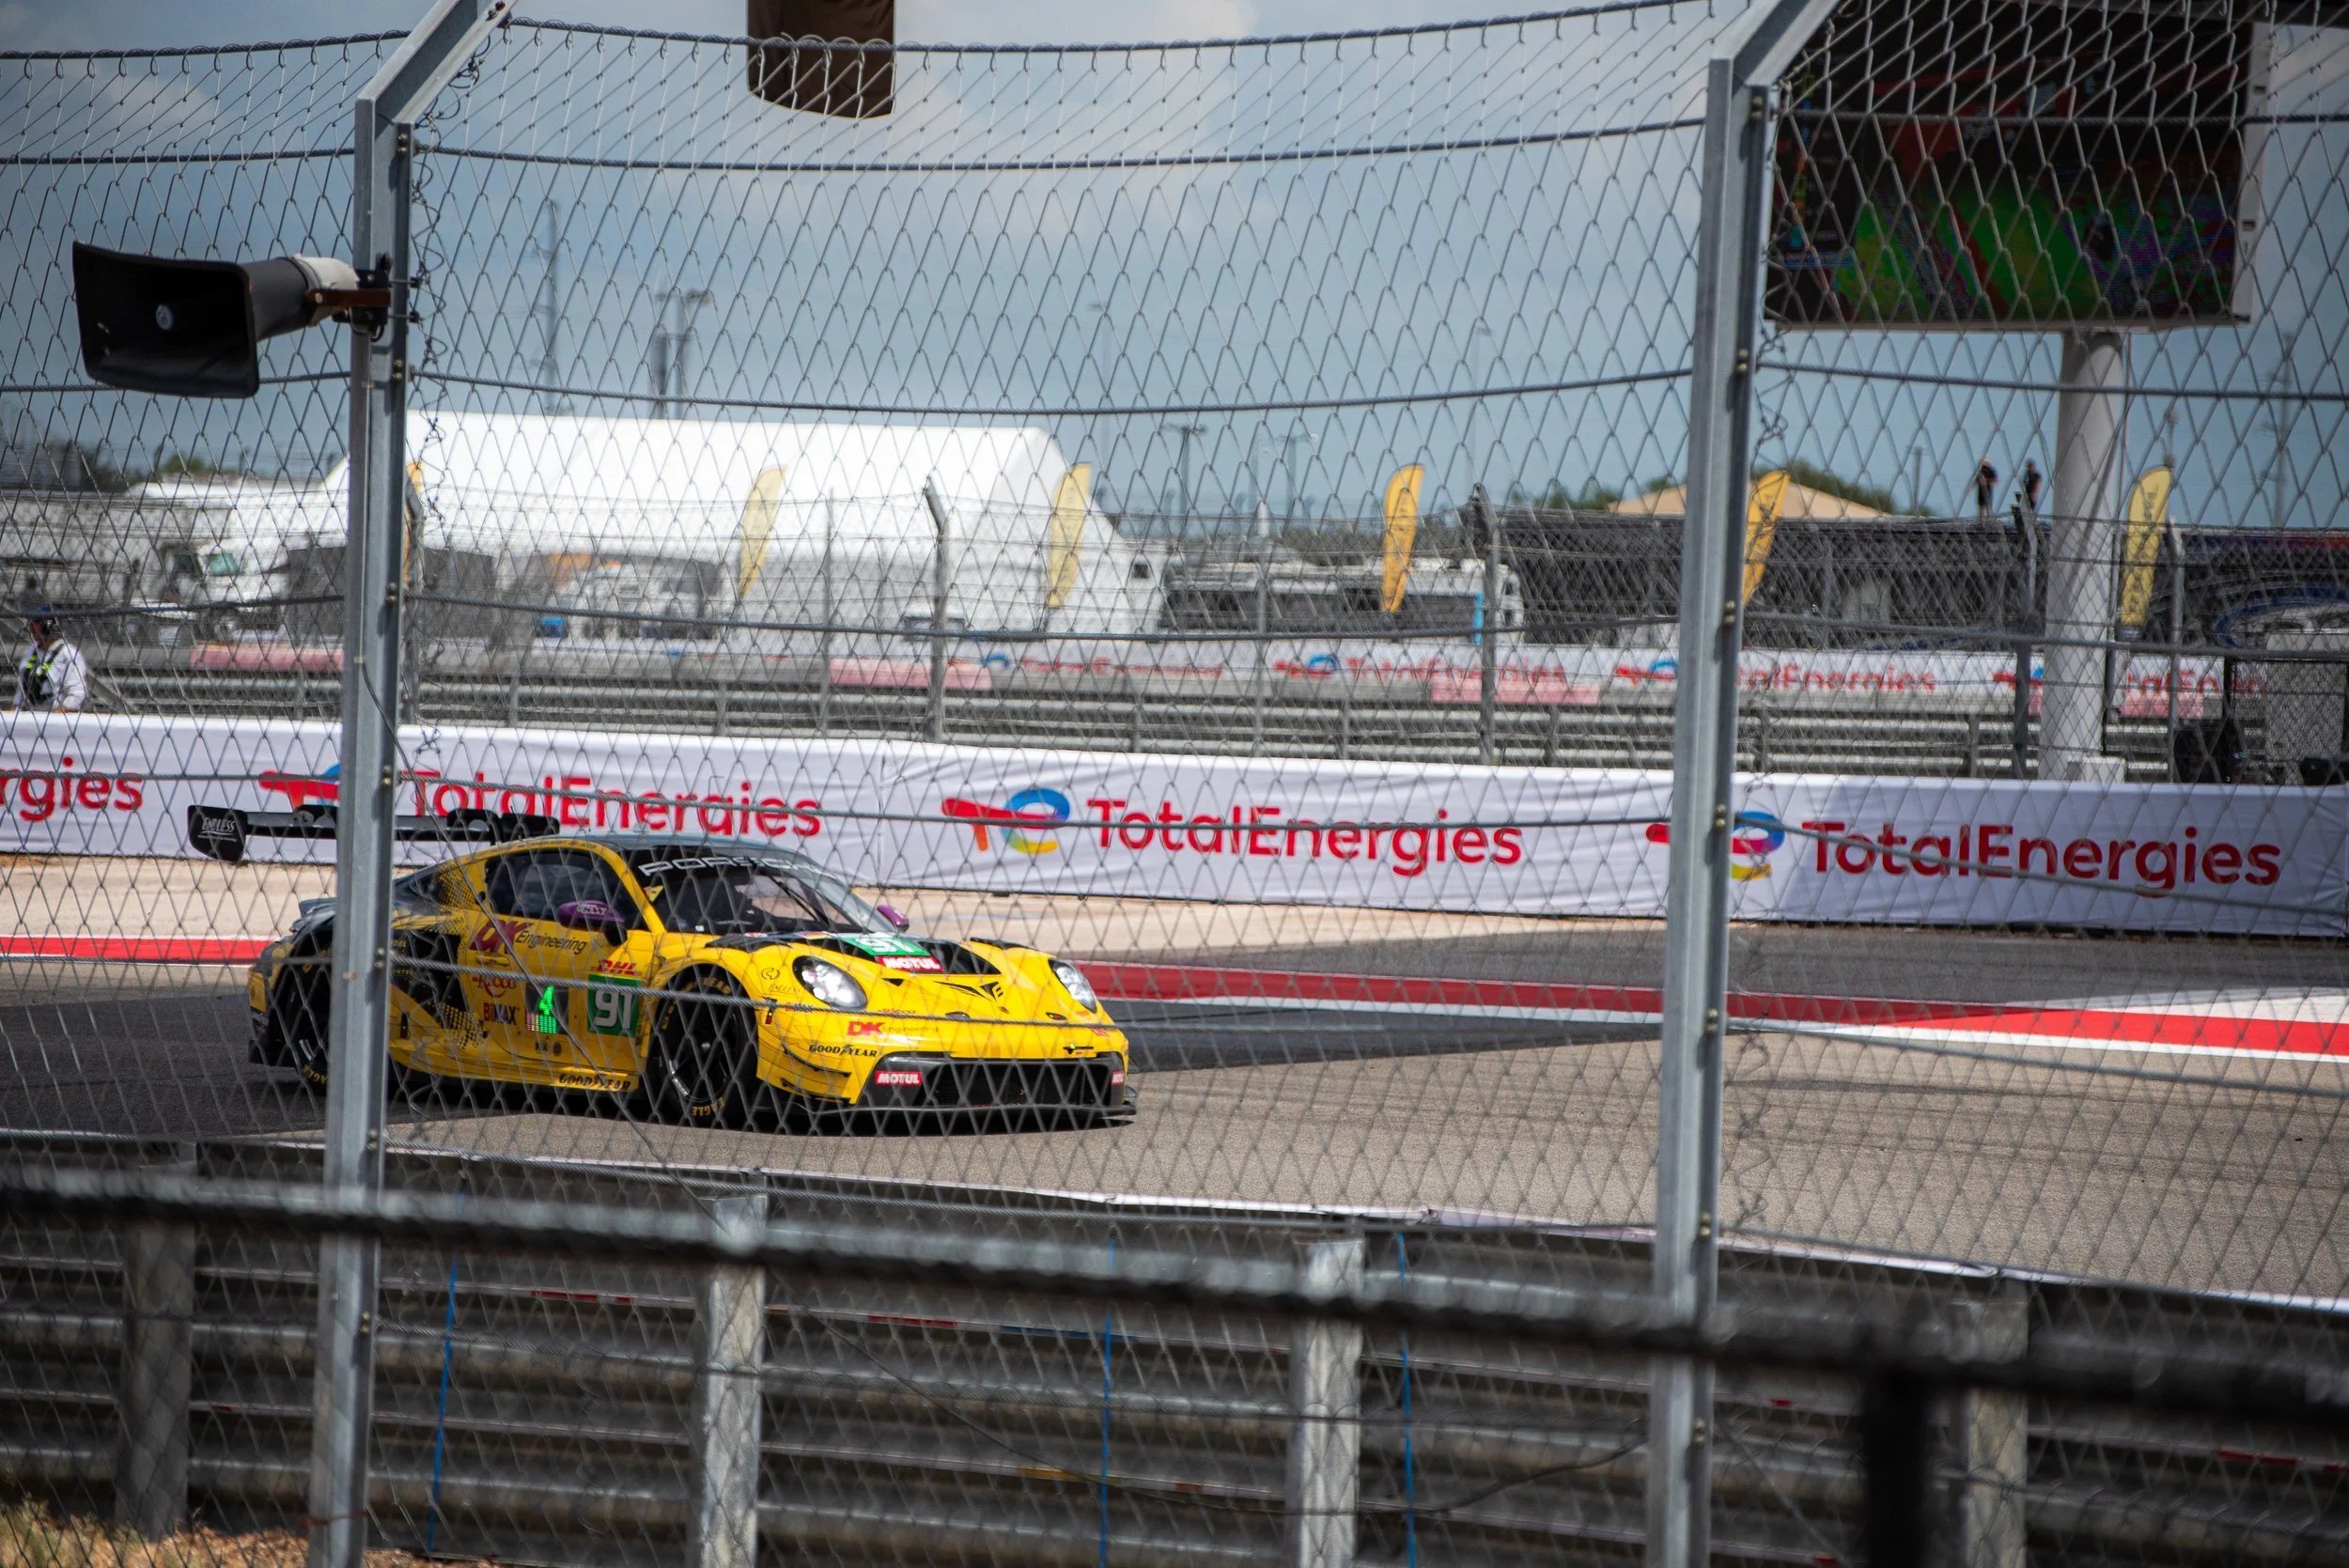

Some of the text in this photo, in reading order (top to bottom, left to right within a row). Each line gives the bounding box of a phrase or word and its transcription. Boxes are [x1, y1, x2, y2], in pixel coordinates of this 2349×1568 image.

[401, 769, 822, 836] TotalEnergies
[1085, 798, 1522, 877] TotalEnergies
[1800, 820, 2280, 897] TotalEnergies
[515, 930, 587, 955] Engineering
[594, 959, 640, 976] DHL
[882, 957, 941, 970] MOTUL
[594, 986, 634, 1031] 91
[848, 1020, 885, 1036] DK
[808, 1044, 878, 1058] GOODYEAR
[877, 1073, 920, 1084] MOTUL
